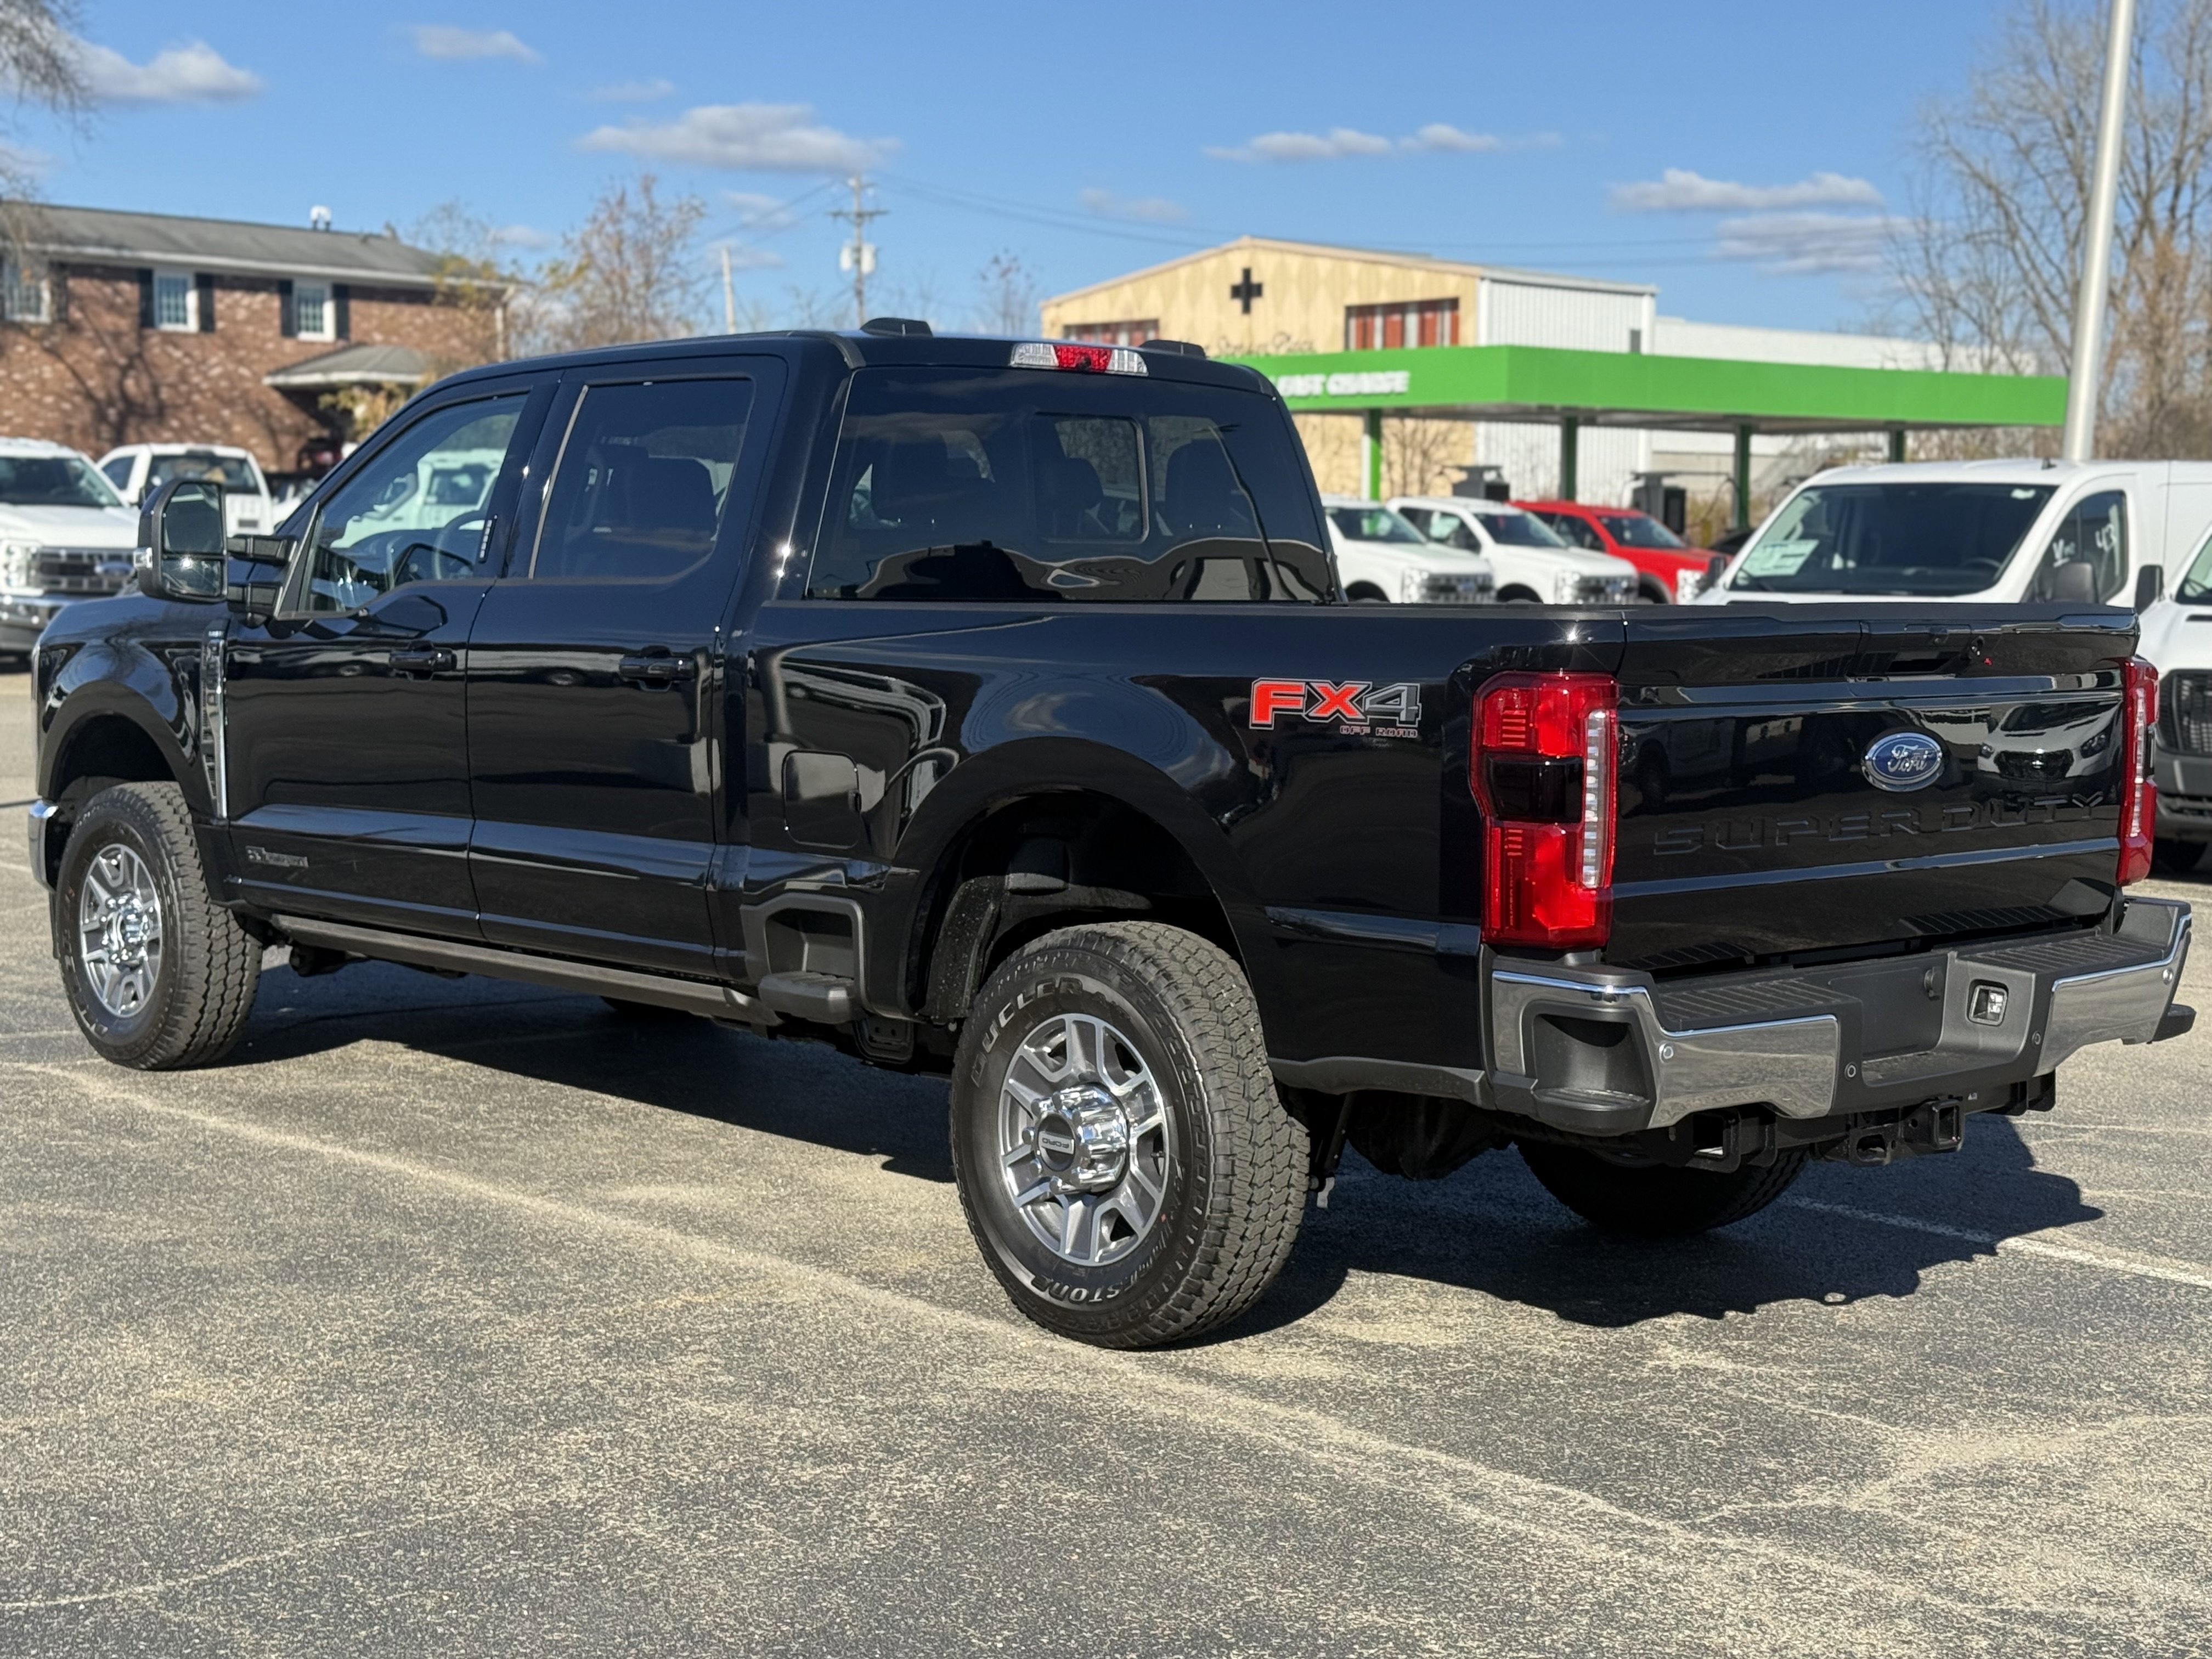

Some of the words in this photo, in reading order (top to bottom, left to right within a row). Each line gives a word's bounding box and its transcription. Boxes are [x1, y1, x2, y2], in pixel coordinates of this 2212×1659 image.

[1249, 677, 1422, 730] FX4
[1340, 725, 1371, 736] OFF
[1375, 727, 1418, 738] ROAD
[1653, 808, 1922, 856] SUPER
[1941, 790, 2104, 833] DUTY
[1042, 1137, 1069, 1150] FORD
